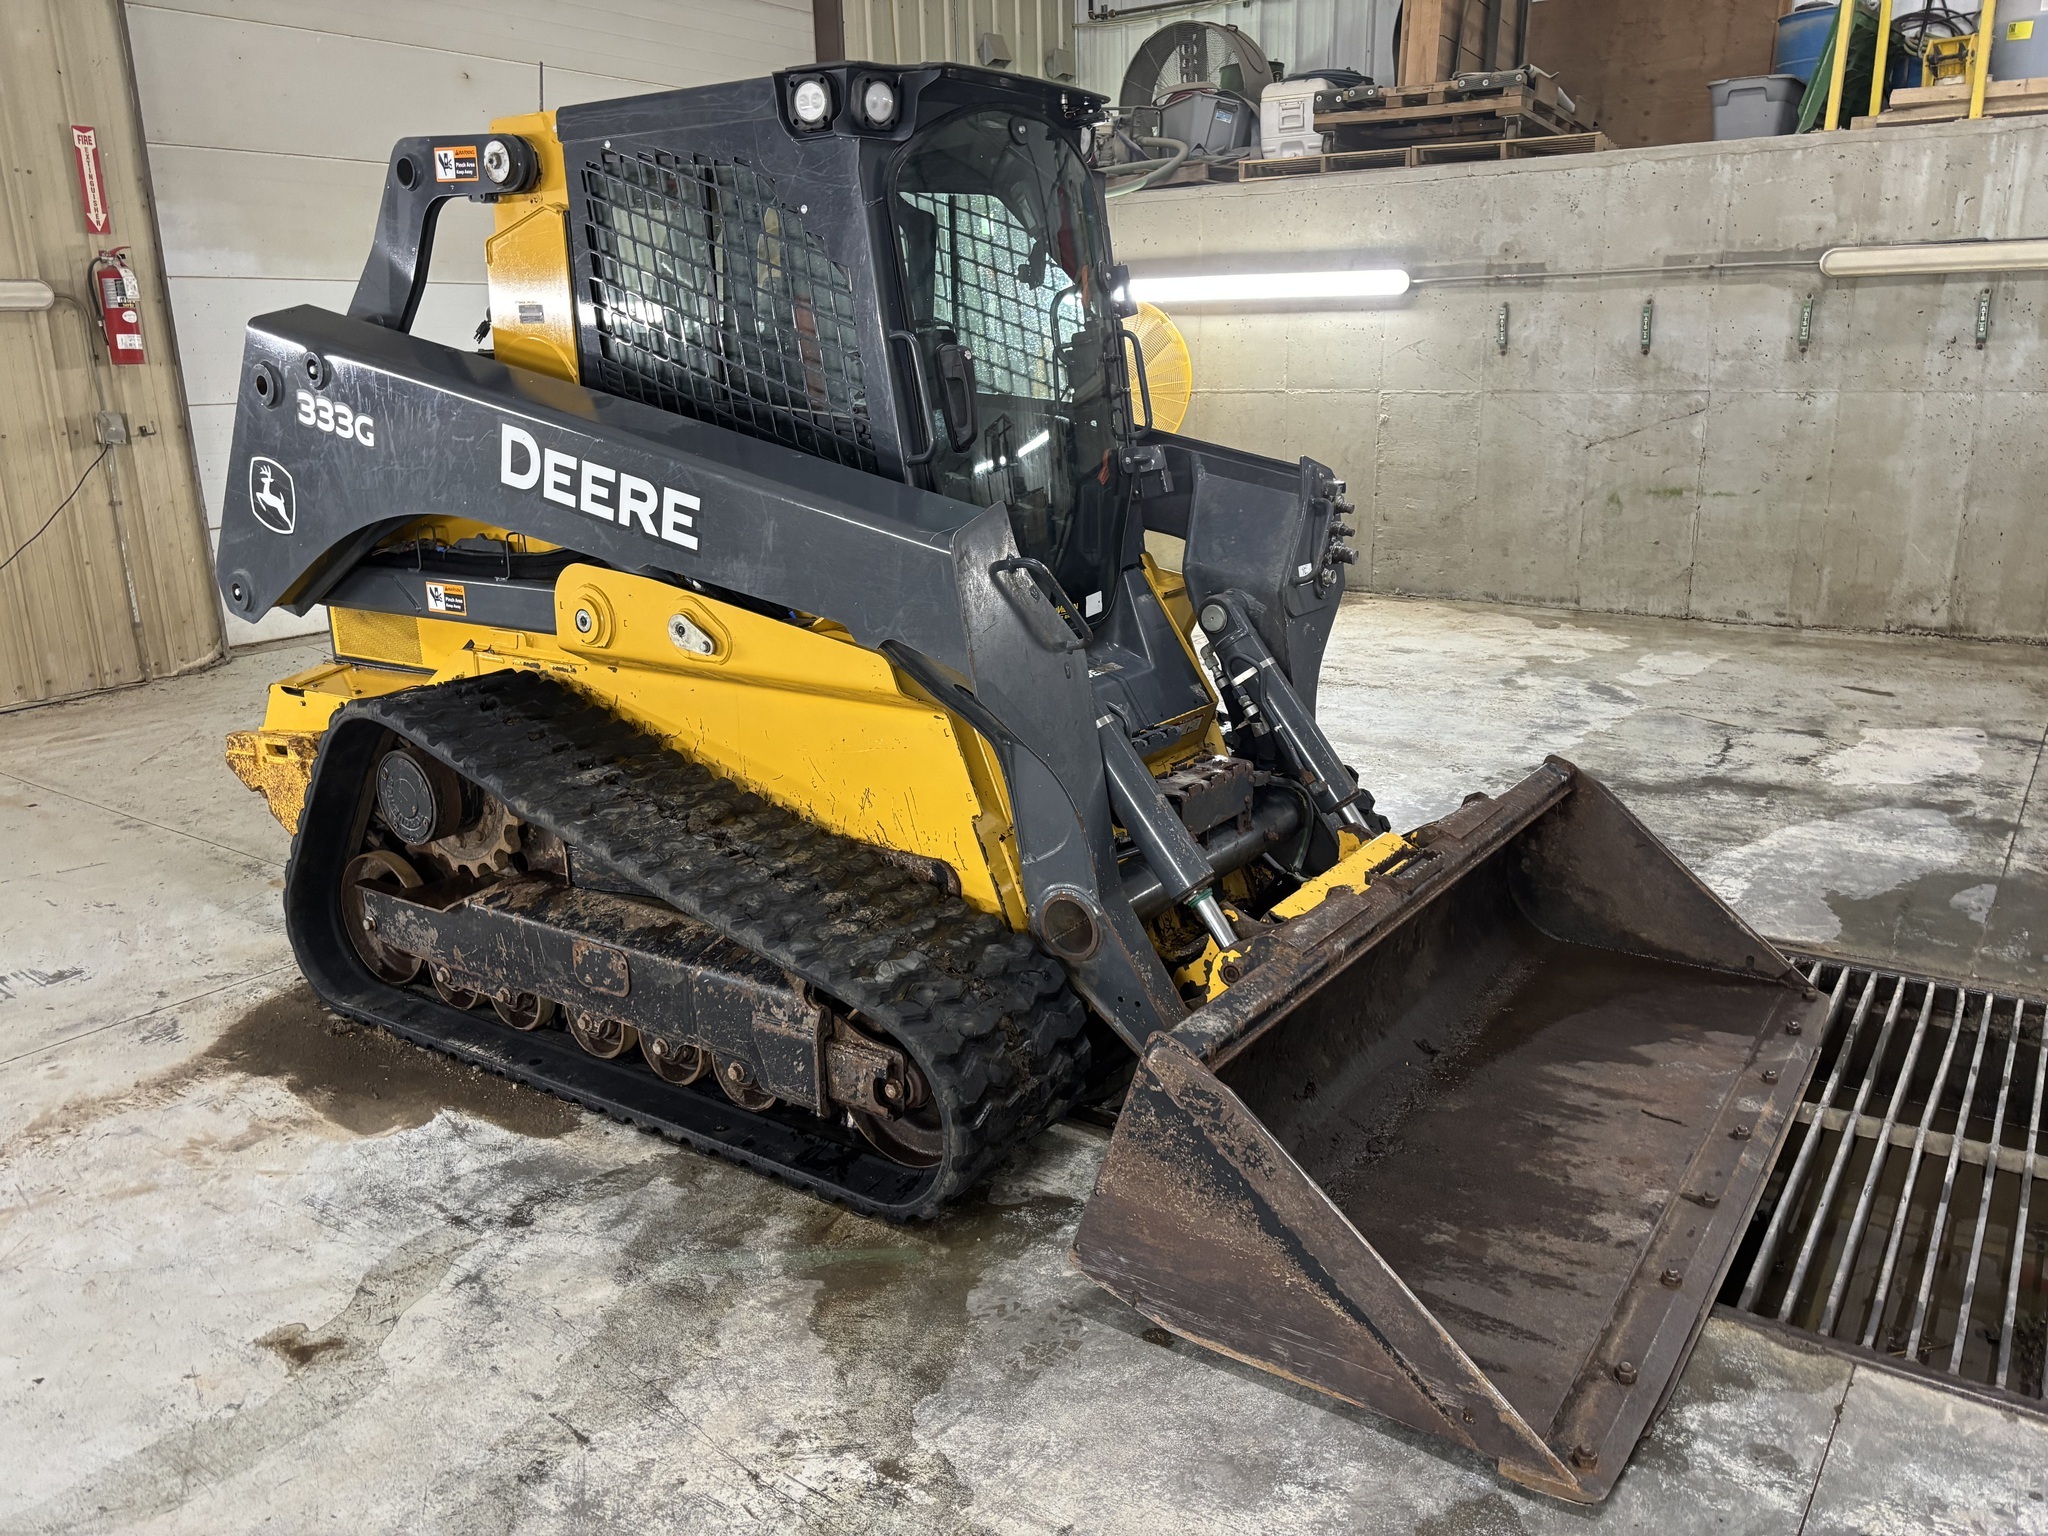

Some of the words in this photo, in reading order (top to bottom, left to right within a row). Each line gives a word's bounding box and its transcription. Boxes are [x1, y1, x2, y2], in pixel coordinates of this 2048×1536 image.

[77, 134, 93, 146] FIRE
[84, 147, 101, 226] EXTINGUISHER
[297, 390, 375, 448] 333G
[501, 422, 701, 551] DEERE
